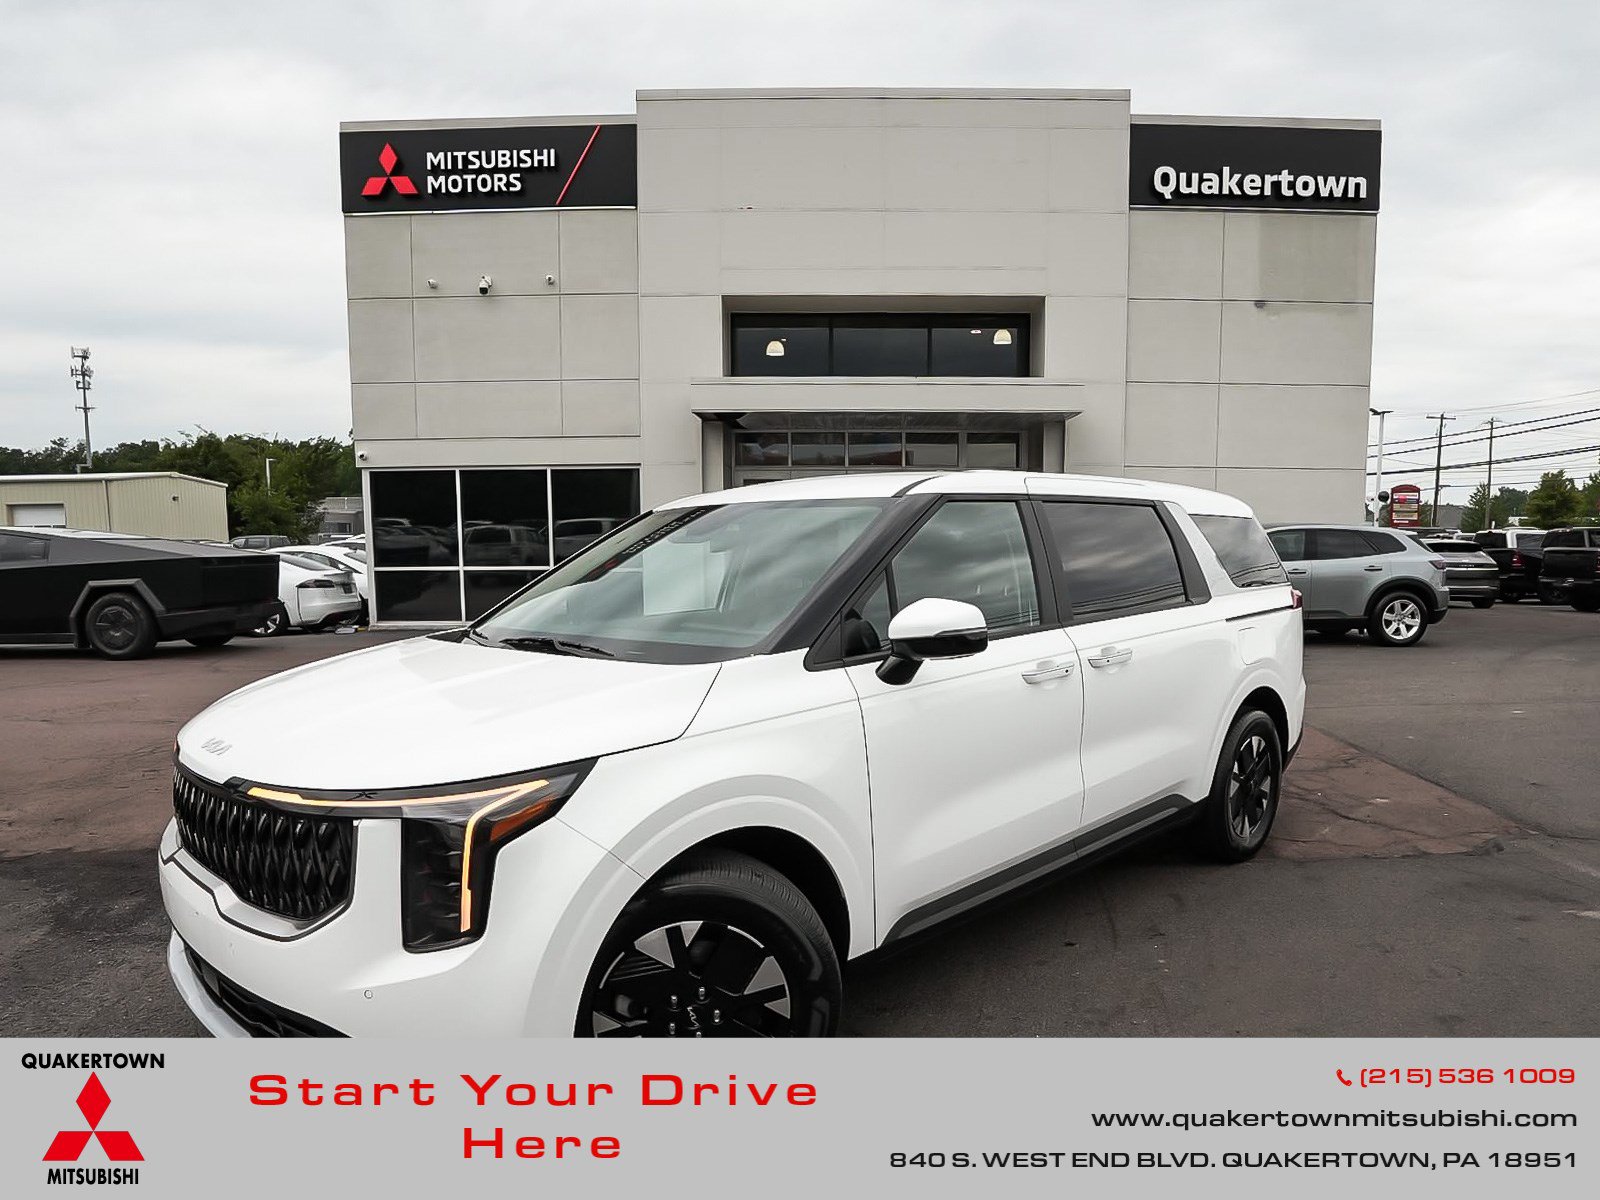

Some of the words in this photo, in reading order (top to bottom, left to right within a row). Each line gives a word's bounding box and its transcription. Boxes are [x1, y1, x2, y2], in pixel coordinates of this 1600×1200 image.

[426, 148, 556, 170] MITSUBISHI
[426, 173, 522, 194] MOTORS
[1153, 165, 1367, 200] Quakertown
